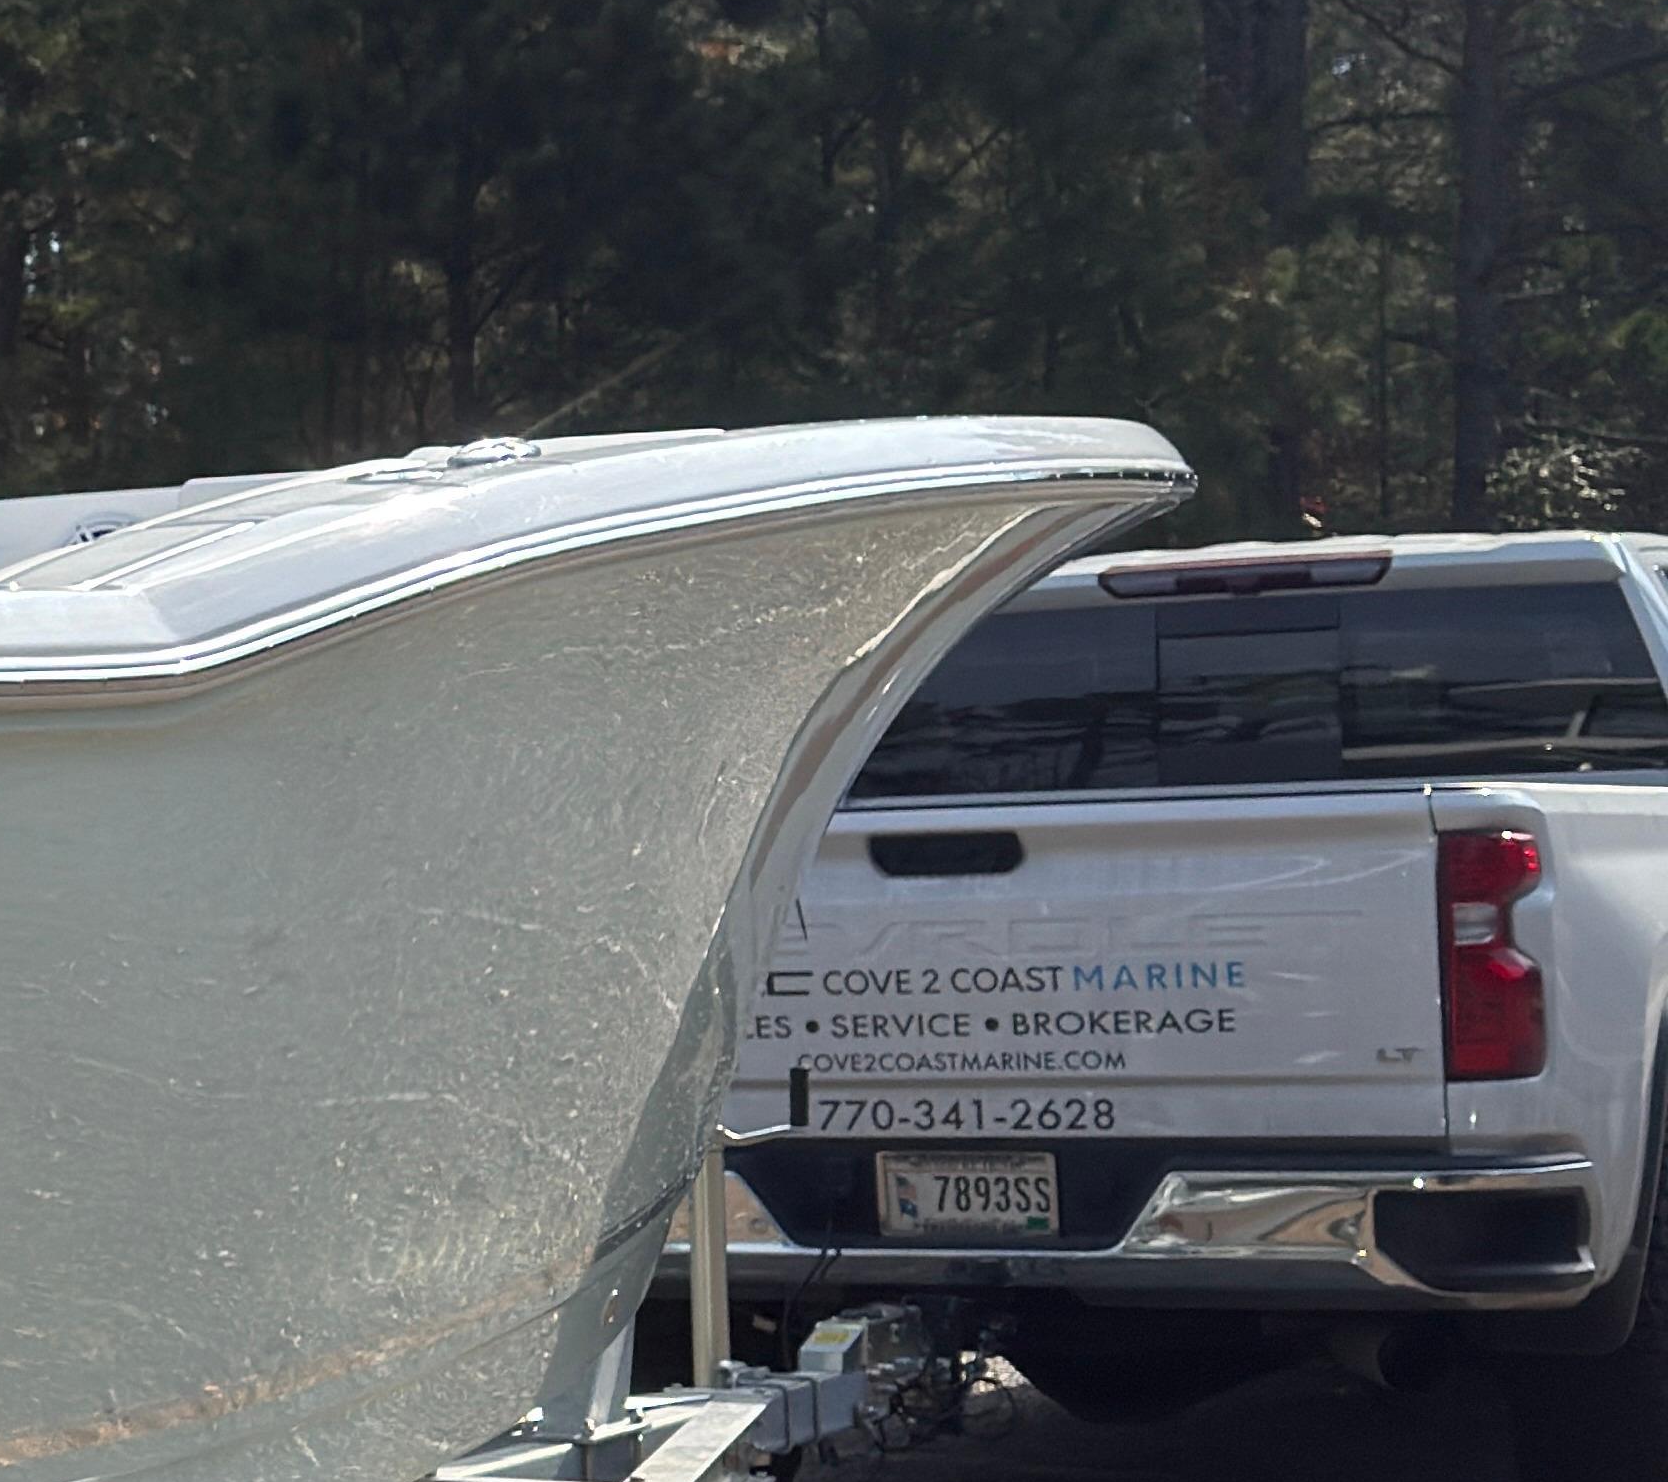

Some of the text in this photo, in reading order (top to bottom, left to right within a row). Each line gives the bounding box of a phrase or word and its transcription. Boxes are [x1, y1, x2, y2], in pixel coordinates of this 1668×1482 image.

[822, 968, 913, 997] COVE
[921, 968, 942, 995] 2
[949, 965, 1064, 994] COAST
[1072, 960, 1247, 993] MARINE
[746, 1007, 1237, 1040] ES SERVICE BROKERAGE
[798, 1050, 1127, 1073] COVE2COASTMARINE.COM
[817, 1098, 1116, 1131] 770-341-2628
[933, 1175, 1051, 1213] 7893SS
